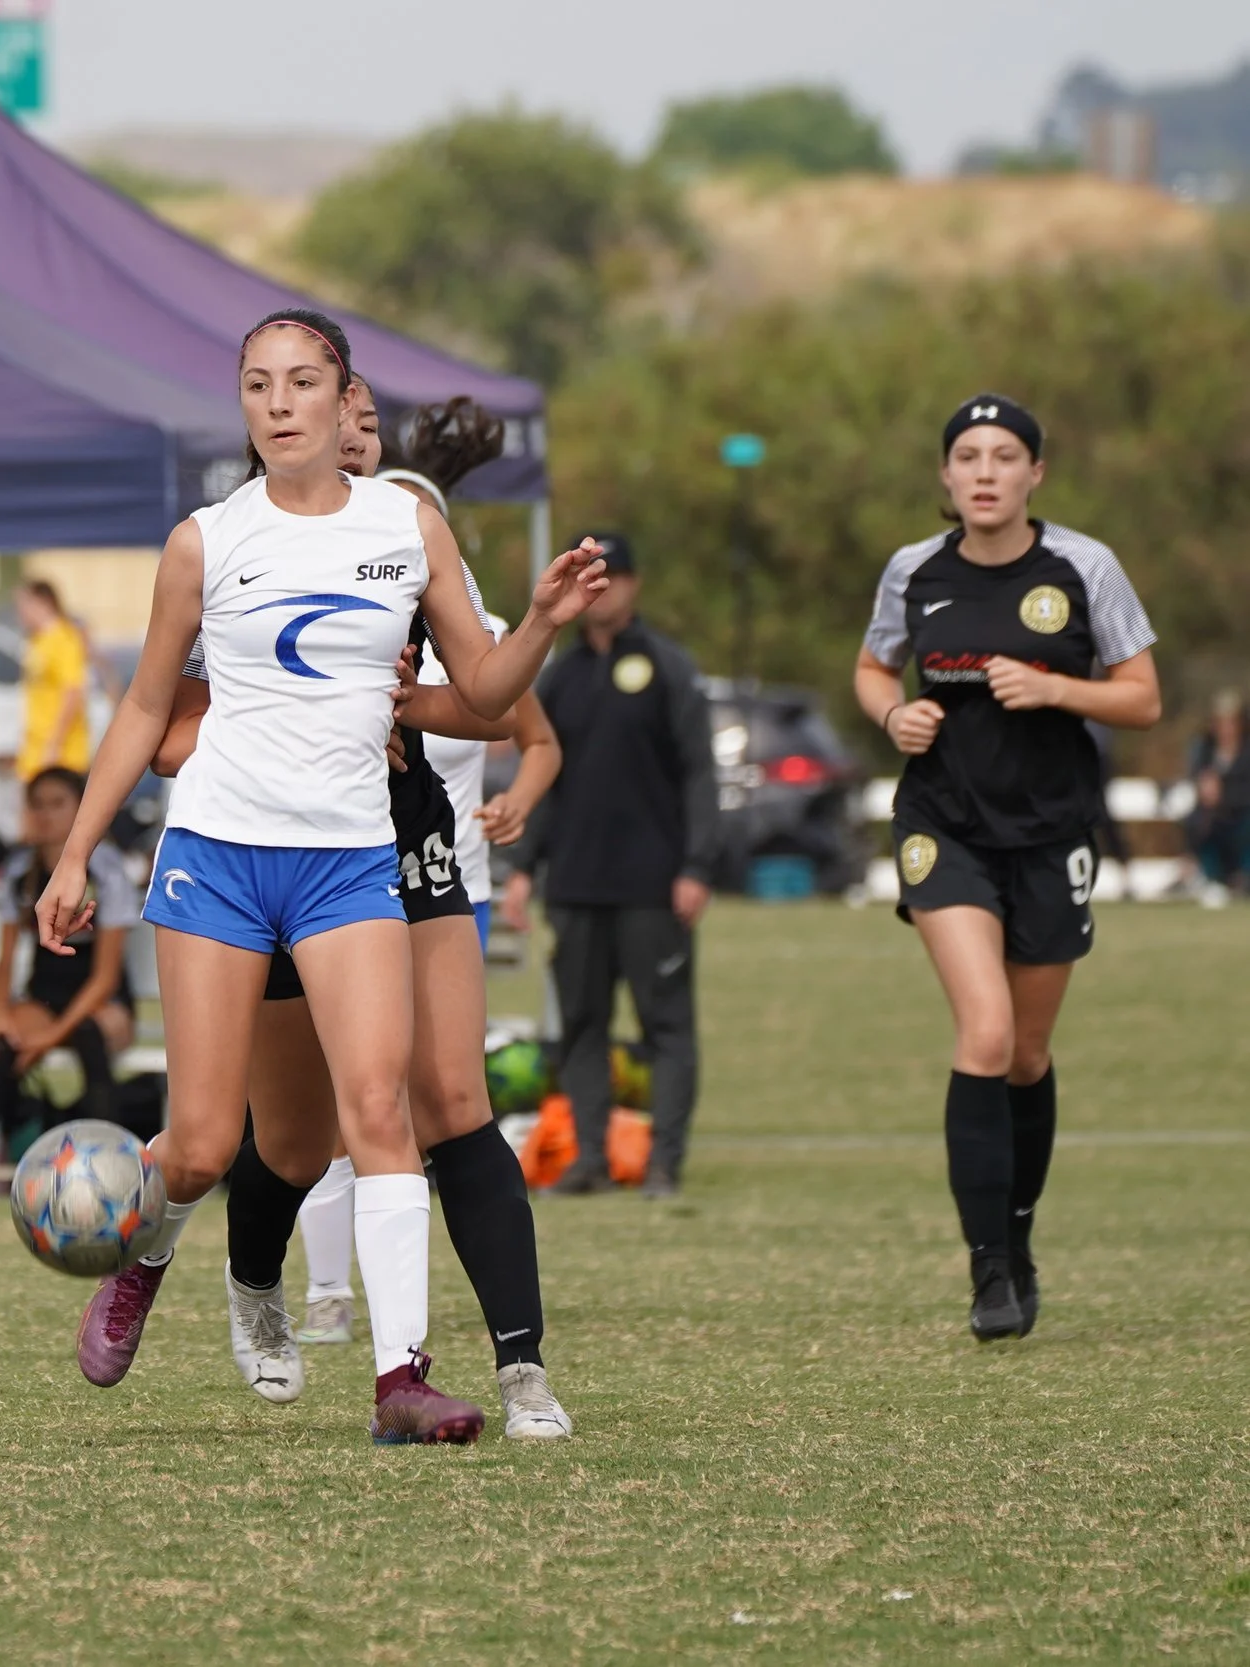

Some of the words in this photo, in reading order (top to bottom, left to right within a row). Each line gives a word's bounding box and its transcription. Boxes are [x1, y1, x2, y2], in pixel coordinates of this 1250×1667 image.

[355, 564, 408, 581] SURF
[400, 832, 454, 890] 19
[1066, 846, 1093, 906] 9
